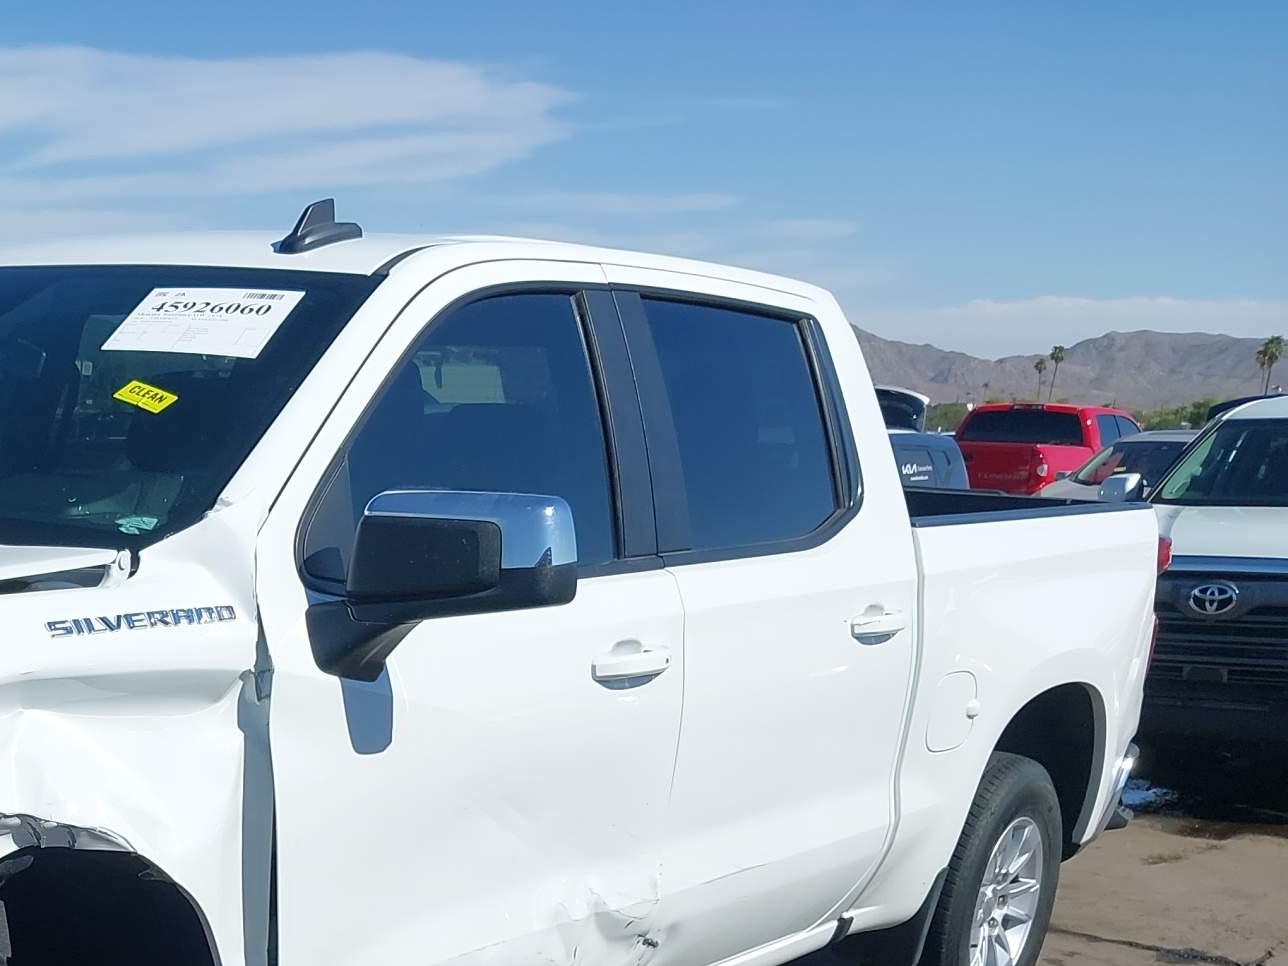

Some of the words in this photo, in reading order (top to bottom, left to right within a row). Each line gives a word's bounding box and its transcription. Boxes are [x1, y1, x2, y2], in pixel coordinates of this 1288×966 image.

[151, 301, 272, 316] 45926060
[128, 385, 168, 405] CLEAN
[45, 605, 237, 638] SILVERADO
